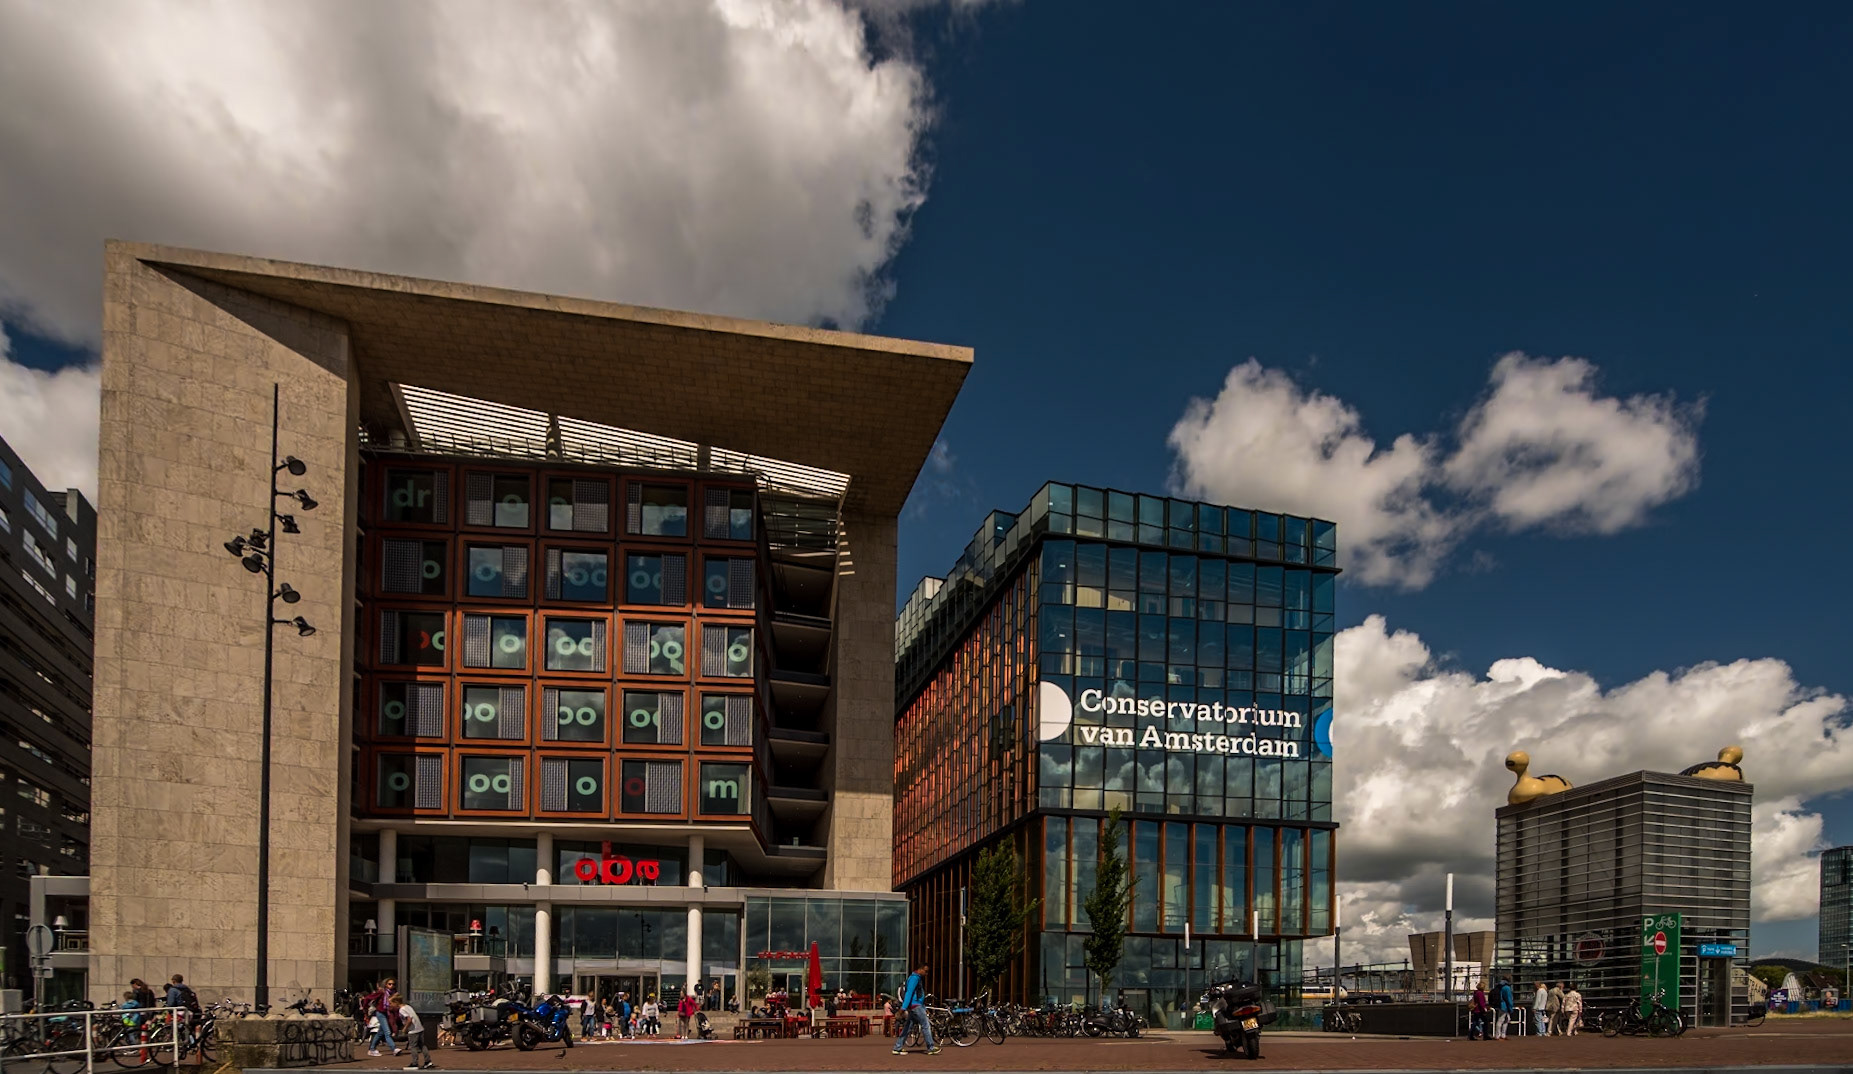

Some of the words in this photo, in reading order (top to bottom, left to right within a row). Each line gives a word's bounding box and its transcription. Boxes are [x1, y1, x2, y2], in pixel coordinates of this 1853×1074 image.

[1080, 688, 1302, 728] Conservatorium
[1080, 725, 1135, 747] van
[1139, 725, 1300, 758] Amsterdam
[709, 779, 738, 799] m
